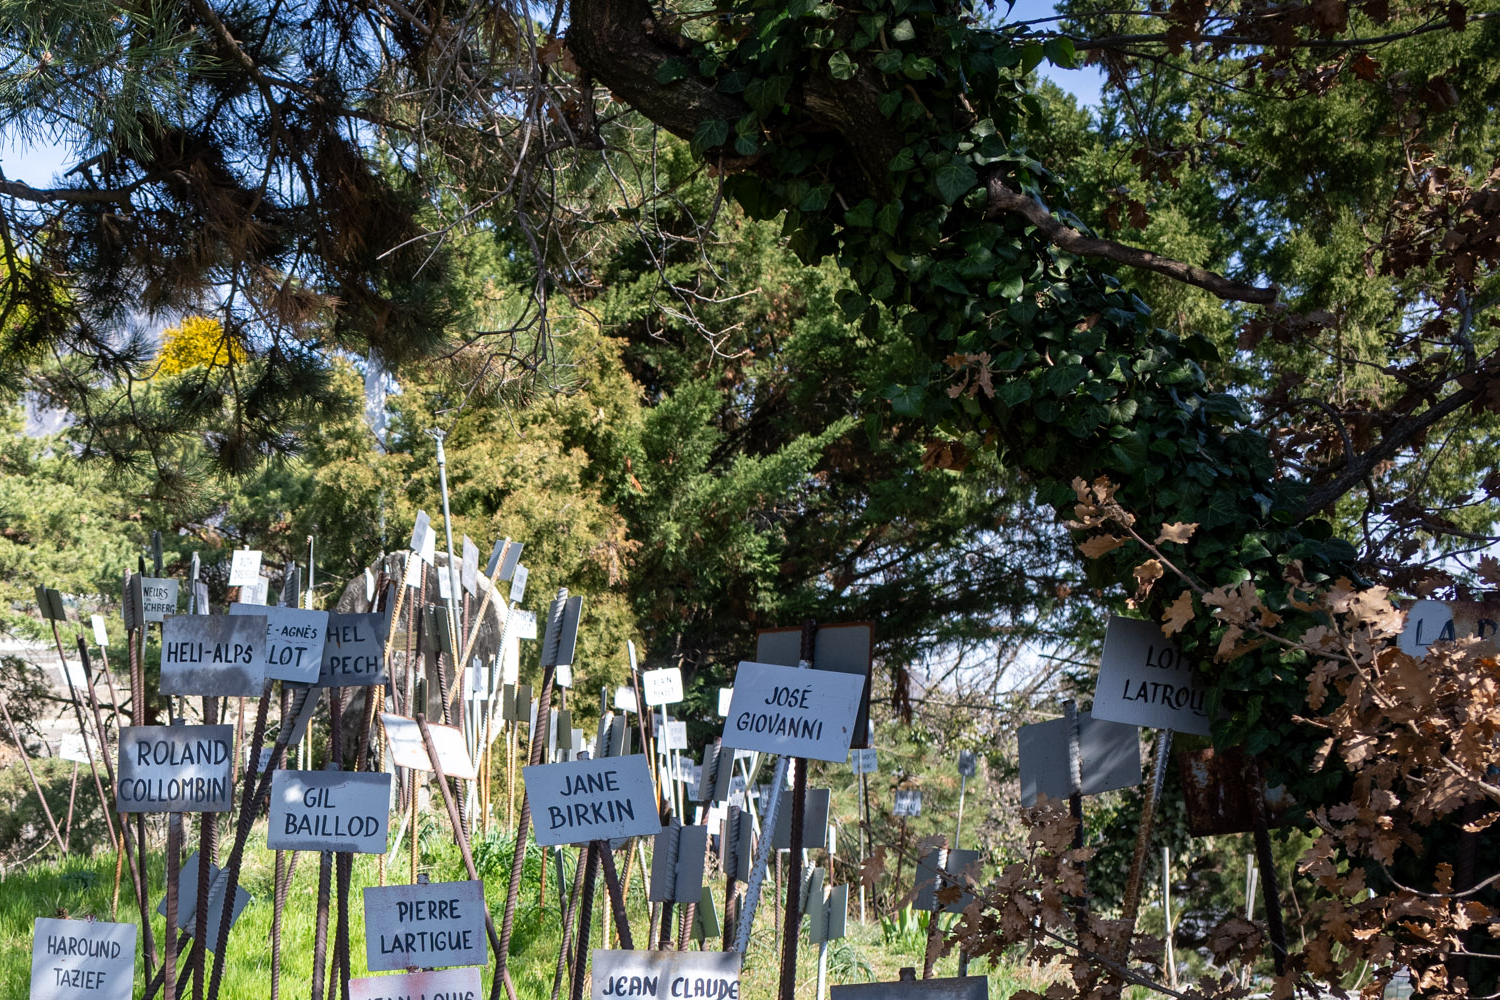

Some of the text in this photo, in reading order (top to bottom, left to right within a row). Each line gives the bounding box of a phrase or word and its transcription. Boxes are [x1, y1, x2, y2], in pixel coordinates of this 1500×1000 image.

[143, 586, 168, 600] NEURS
[266, 624, 318, 640] E-AGNÈS
[326, 625, 366, 643] HEL
[167, 642, 253, 664] HELI-ALPS
[265, 644, 308, 667] LOT
[1145, 644, 1192, 673] LOT
[320, 655, 379, 677] PECH
[765, 684, 812, 709] JOSÉ
[1122, 678, 1208, 717] LATROU
[736, 711, 823, 741] GIOVANNI
[137, 739, 229, 767] ROLAND
[118, 777, 227, 802] COLLOMBIN
[560, 770, 621, 797] JANE
[303, 787, 336, 809] GIL
[285, 812, 379, 837] BAILLOD
[548, 798, 636, 830] BIRKIN
[396, 899, 462, 922] PIERRE
[47, 935, 122, 960] HAROUND
[380, 930, 473, 955] LARTIGUE
[53, 967, 107, 991] TAZIEF
[602, 975, 741, 1000] JEAN CLAUDE
